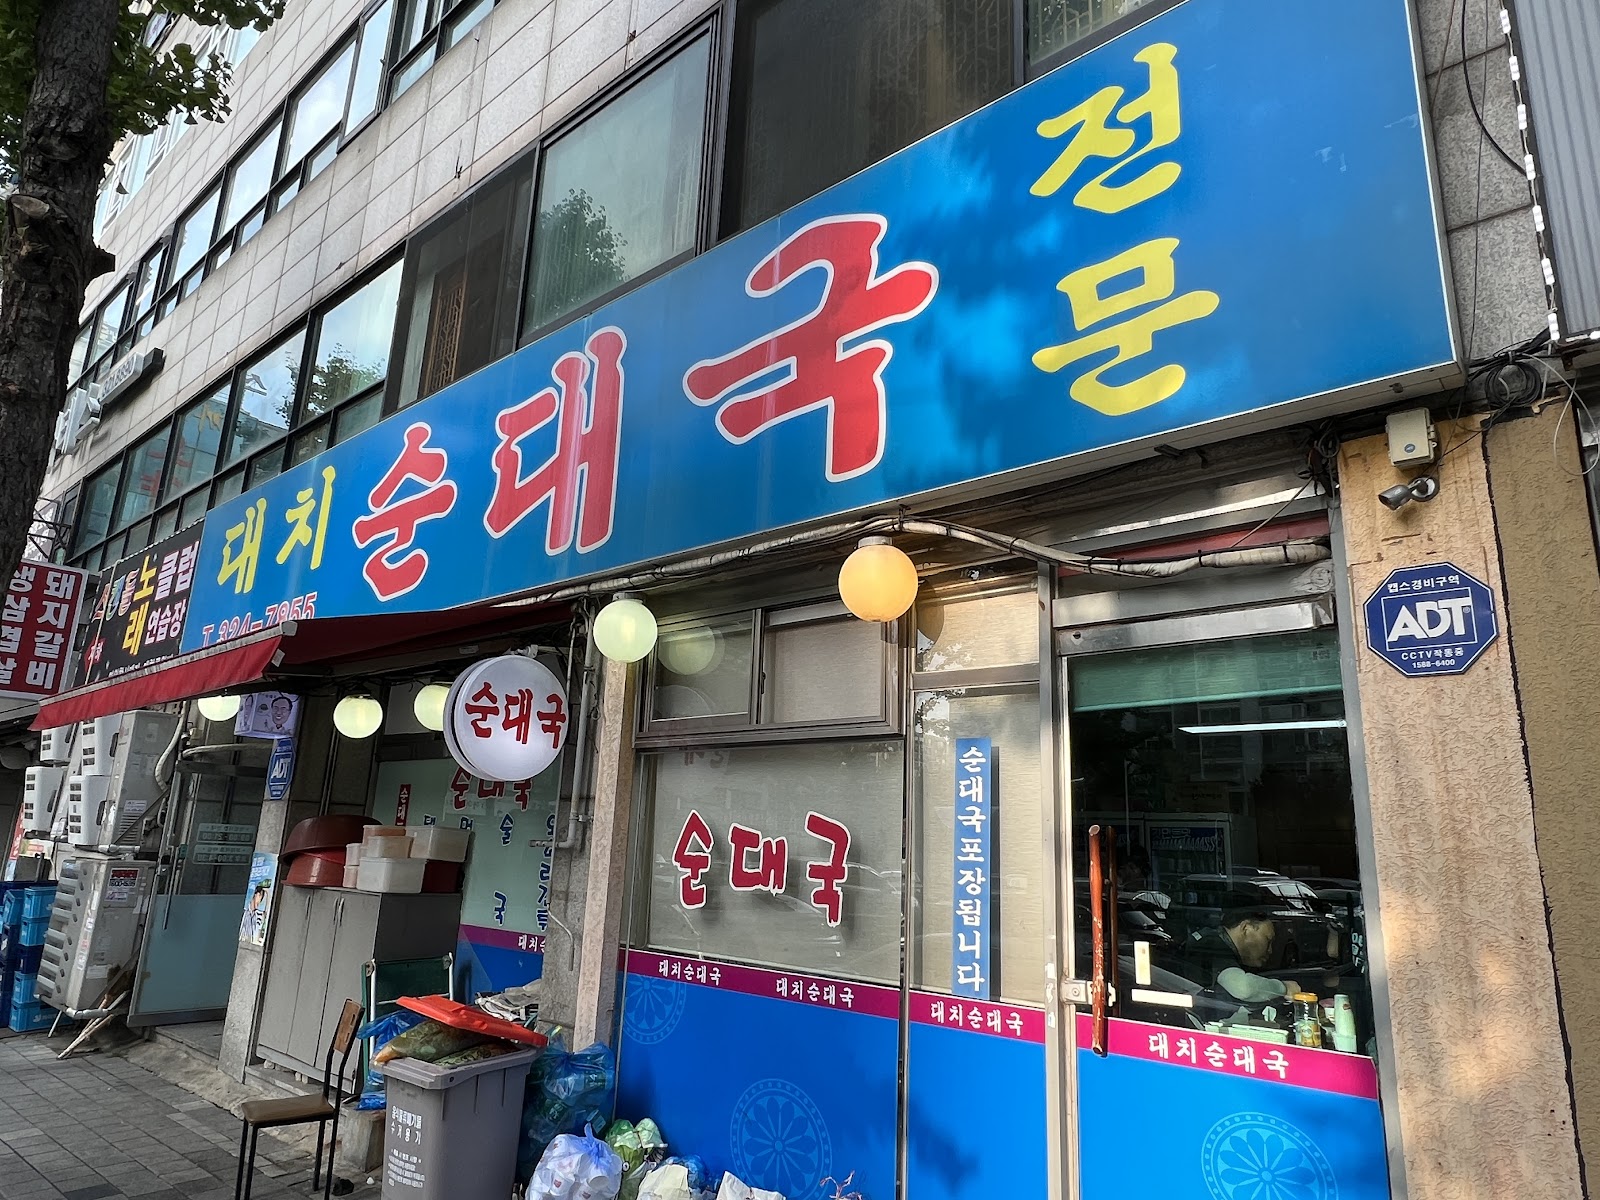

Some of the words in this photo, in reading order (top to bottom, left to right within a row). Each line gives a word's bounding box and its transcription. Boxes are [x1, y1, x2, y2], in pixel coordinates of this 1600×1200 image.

[1030, 43, 1220, 416] 전문
[217, 465, 336, 594] 대치
[352, 214, 939, 602] 순대국
[122, 555, 157, 656] 노래
[154, 541, 200, 601] 클럽
[1387, 575, 1460, 593] 캡스경비구역
[0, 566, 36, 685] 생삼겹살
[26, 571, 76, 689] 돼지갈비
[145, 598, 187, 645] 연습장
[1388, 597, 1472, 642] ADT
[1412, 659, 1456, 669] 1588-6400
[465, 682, 567, 749] 순대국
[271, 758, 291, 779] ADT
[397, 787, 409, 826] 순대
[673, 810, 851, 927] 순대국
[955, 746, 987, 992] 순대국포장됩니다
[658, 960, 722, 986] 대치순대국
[775, 977, 855, 1008] 대치순대국
[930, 1001, 1024, 1036] 대치순대국
[1148, 1032, 1289, 1079] 대치순대국
